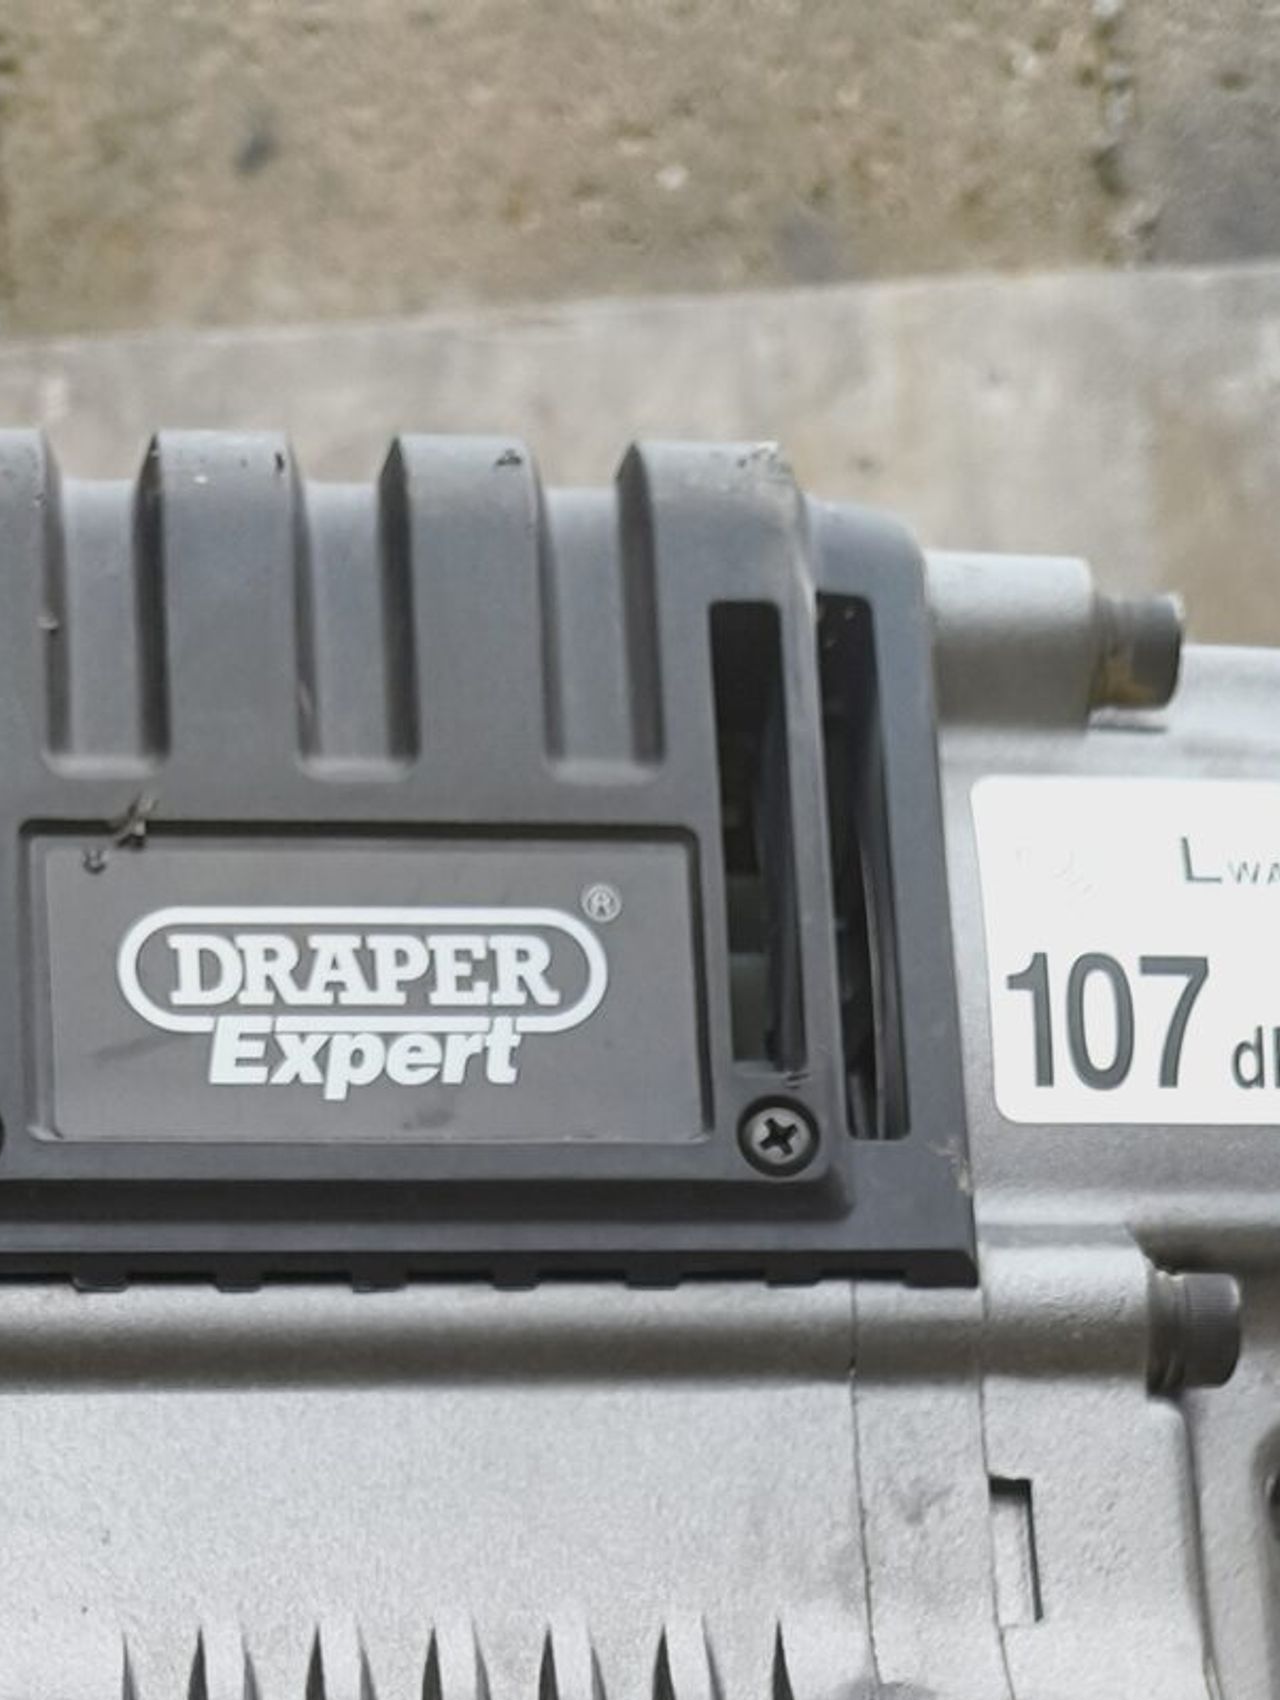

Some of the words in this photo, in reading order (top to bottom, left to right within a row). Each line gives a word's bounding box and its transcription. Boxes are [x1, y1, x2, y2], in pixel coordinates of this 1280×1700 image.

[167, 933, 560, 1006] DRAPER
[208, 1015, 521, 1101] Expert
[1006, 951, 1210, 1091] 107
